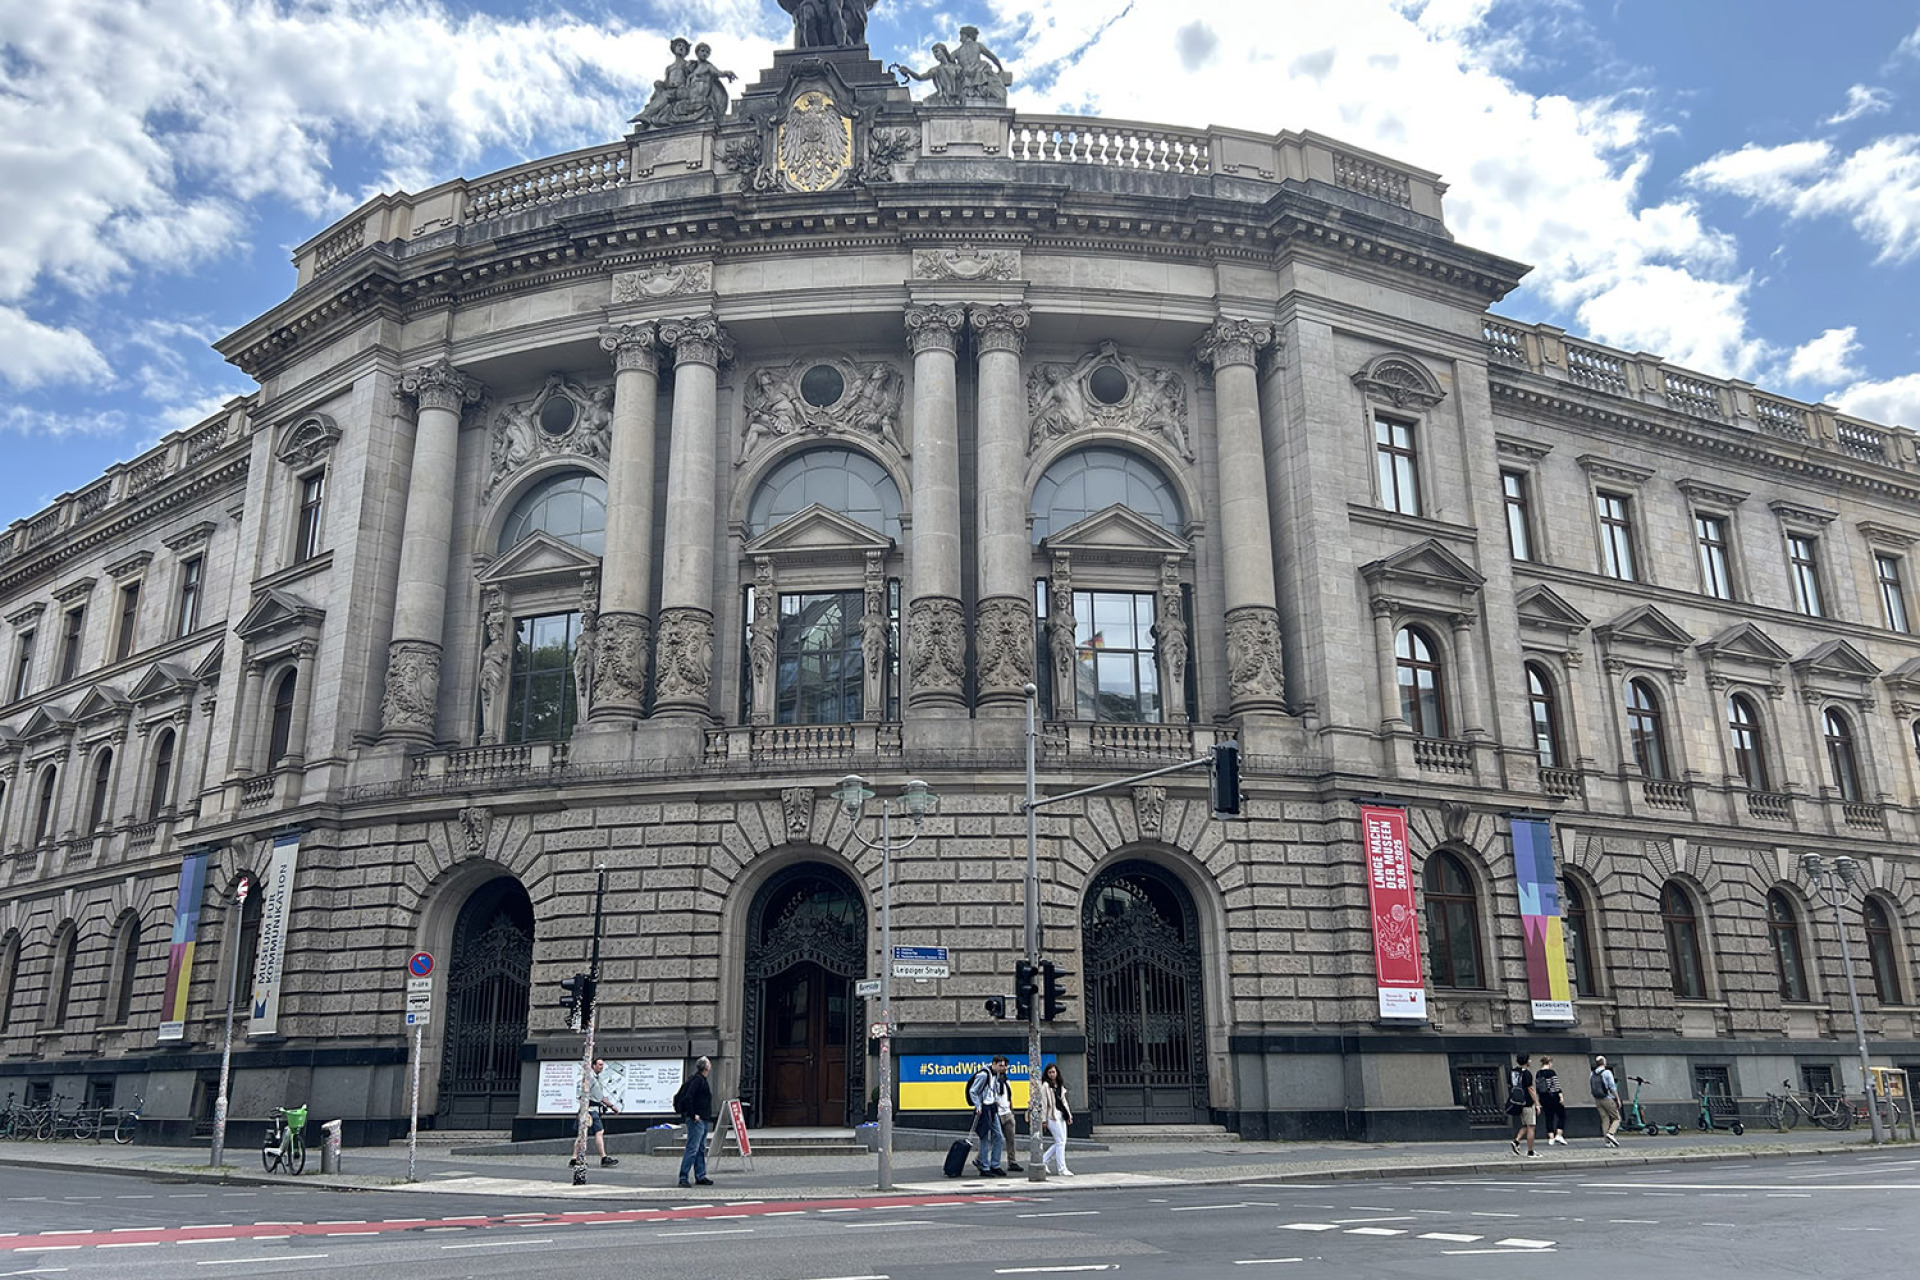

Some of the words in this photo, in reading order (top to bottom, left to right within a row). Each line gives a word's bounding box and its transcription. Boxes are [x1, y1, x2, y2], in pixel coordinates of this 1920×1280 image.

[1369, 819, 1382, 854] NACHT
[1380, 821, 1395, 865] MUSEEN
[1371, 856, 1385, 888] LANGE
[1385, 868, 1397, 889] DER
[1393, 839, 1407, 889] 30.08.2025
[265, 863, 288, 984] KOMMUNIKATION
[258, 921, 272, 984] MUSEUM
[273, 934, 285, 983] BERLIN
[896, 966, 923, 974] Leipziger
[925, 967, 946, 975] Straße
[603, 1045, 683, 1053] KOMMUNIKATION
